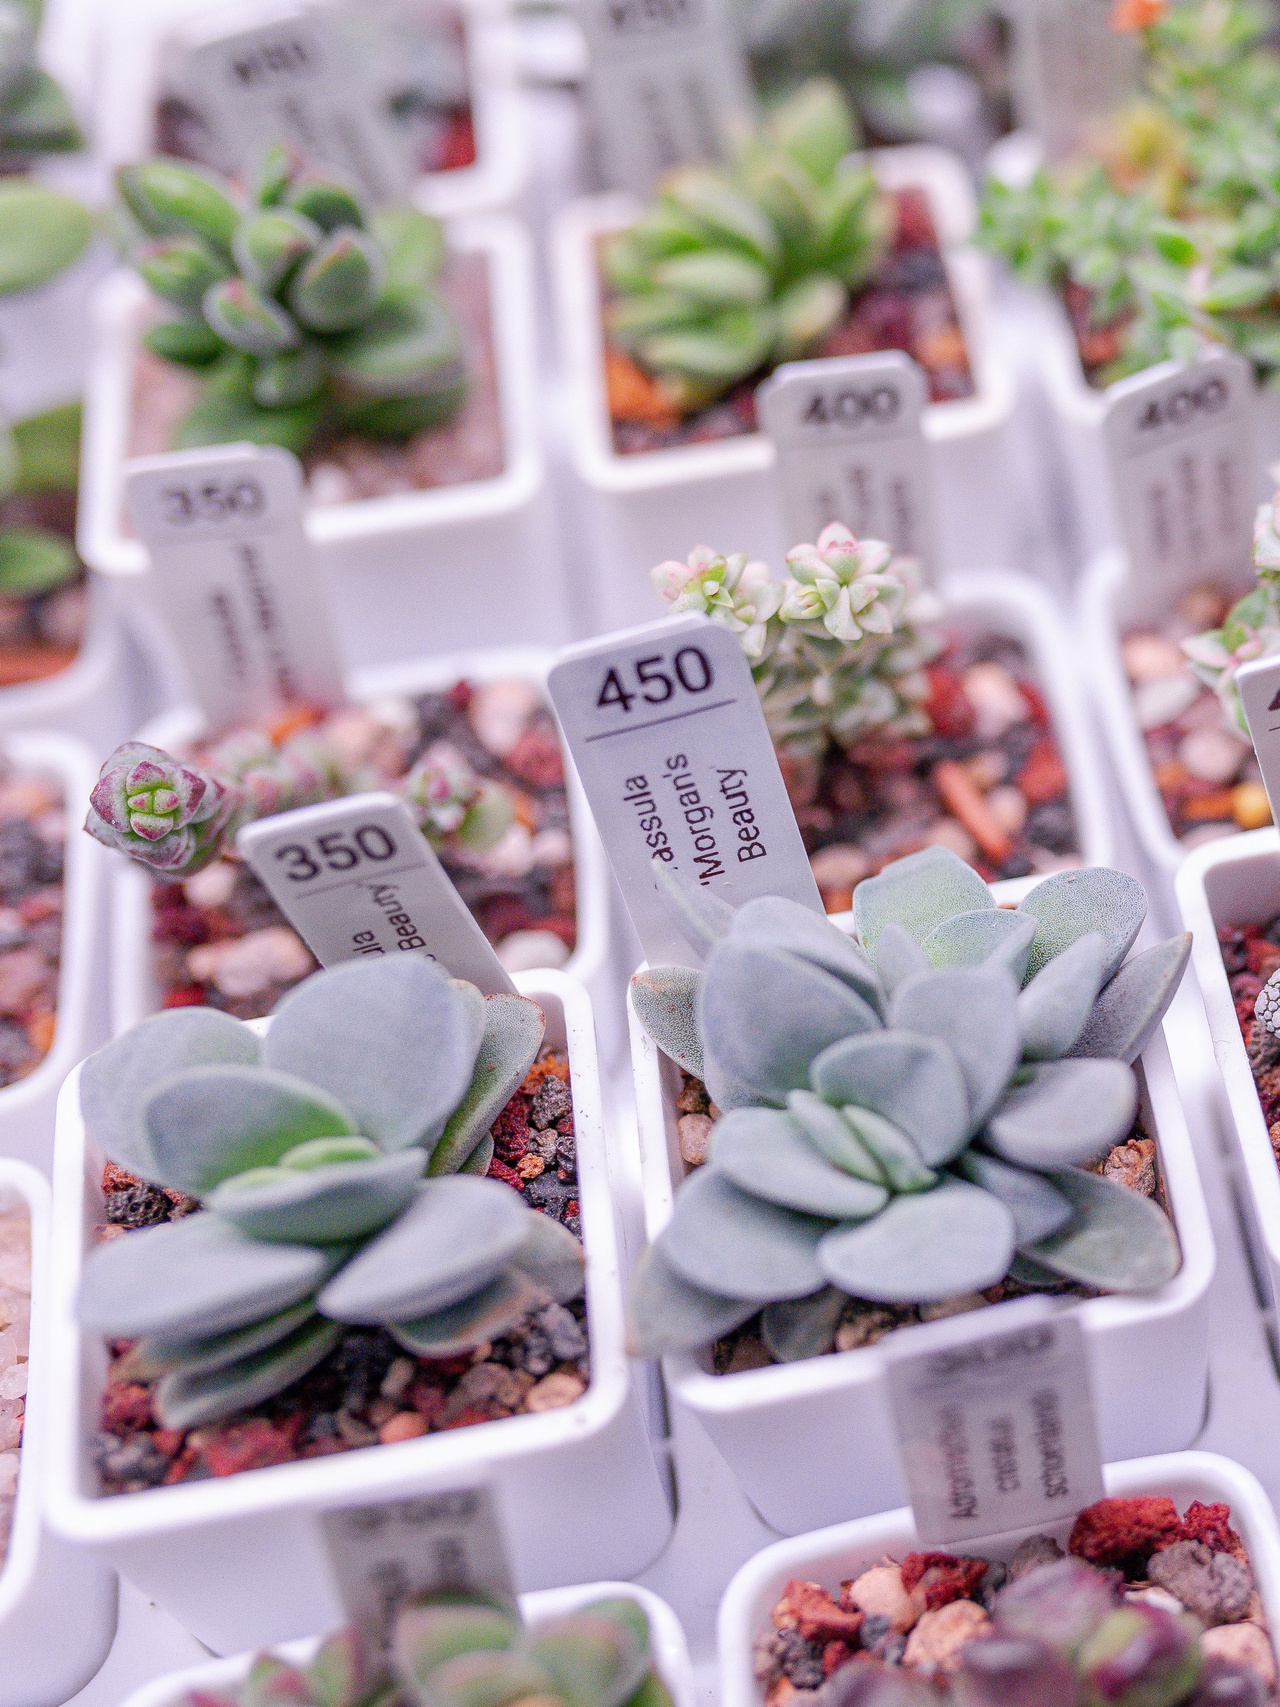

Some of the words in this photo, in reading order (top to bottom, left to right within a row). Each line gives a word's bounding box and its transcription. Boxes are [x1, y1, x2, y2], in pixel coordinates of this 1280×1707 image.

[802, 385, 900, 427] 400
[1136, 376, 1229, 431] 400
[160, 475, 267, 525] 350
[596, 645, 715, 714] 450
[623, 774, 678, 878] assula
[662, 753, 726, 886] 'Morgan's
[715, 766, 768, 863] Beauty
[274, 824, 397, 883] 350
[366, 884, 427, 951] Beauty
